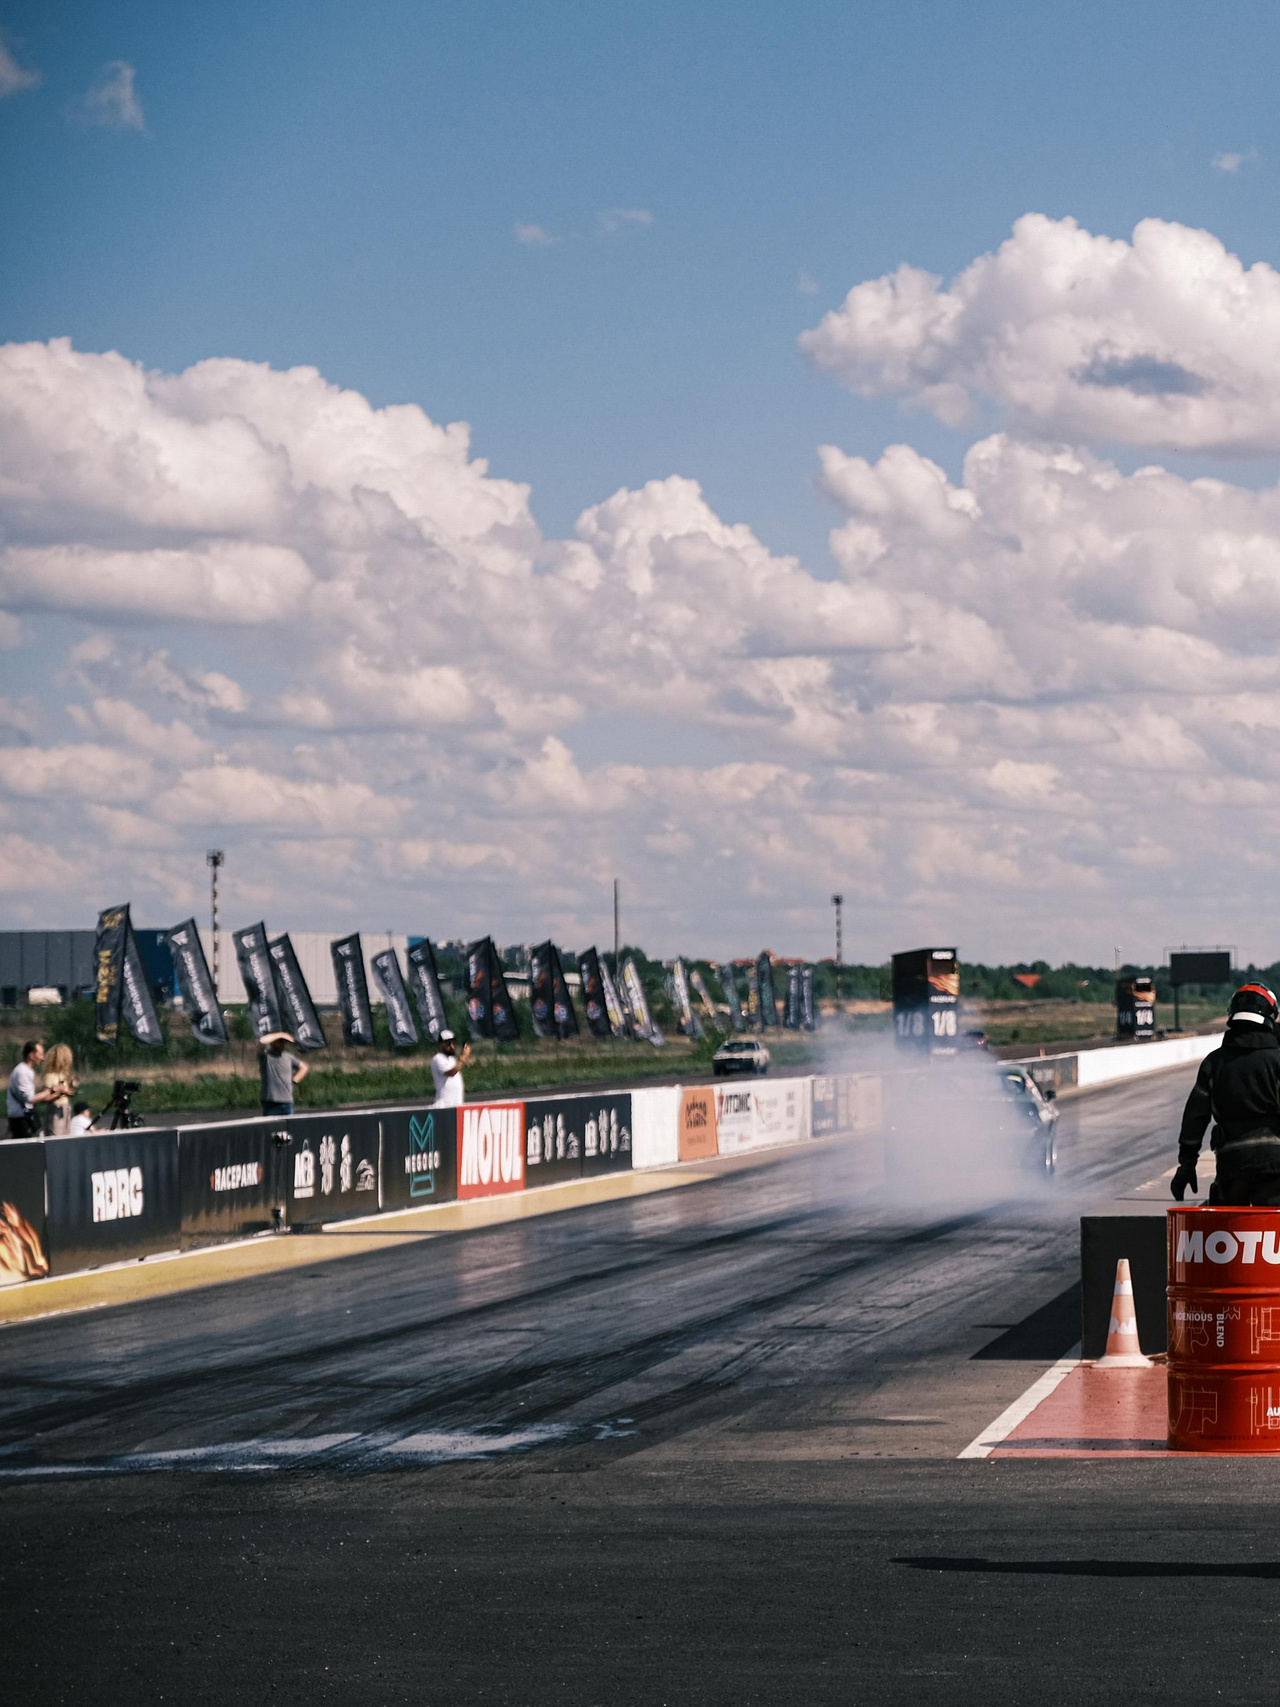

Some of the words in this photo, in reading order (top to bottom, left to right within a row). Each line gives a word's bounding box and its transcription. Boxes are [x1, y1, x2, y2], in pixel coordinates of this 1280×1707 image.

[931, 1010, 957, 1037] 1/8
[405, 1150, 440, 1174] MEGOGO
[460, 1107, 522, 1186] MOTUL
[214, 1161, 259, 1192] RACEPARK
[91, 1166, 143, 1223] RDRC
[1173, 1312, 1213, 1322] INGENIOUS
[1216, 1313, 1225, 1348] BLEND
